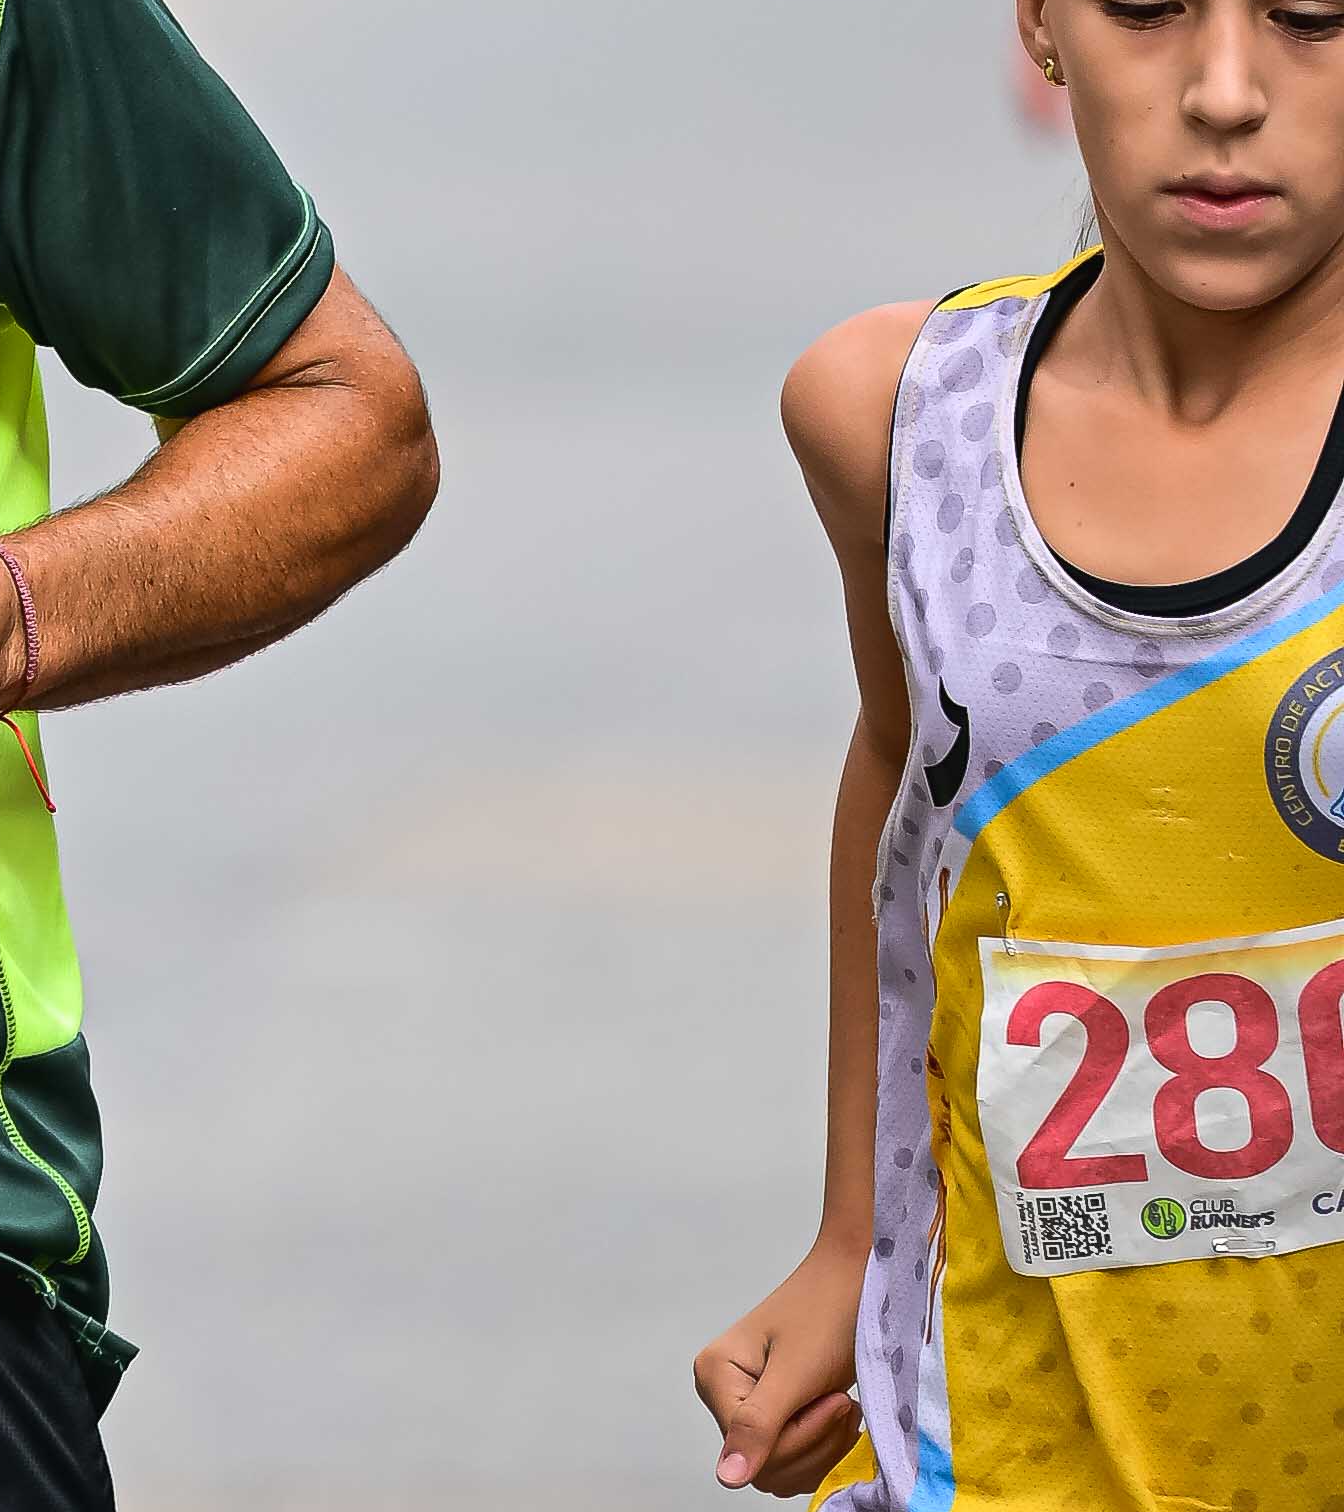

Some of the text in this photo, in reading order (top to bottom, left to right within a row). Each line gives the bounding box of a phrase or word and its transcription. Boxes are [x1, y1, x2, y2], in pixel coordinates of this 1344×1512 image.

[1280, 699, 1306, 732] DE
[1274, 737, 1313, 826] CENTRO
[1190, 1199, 1235, 1214] CLUB
